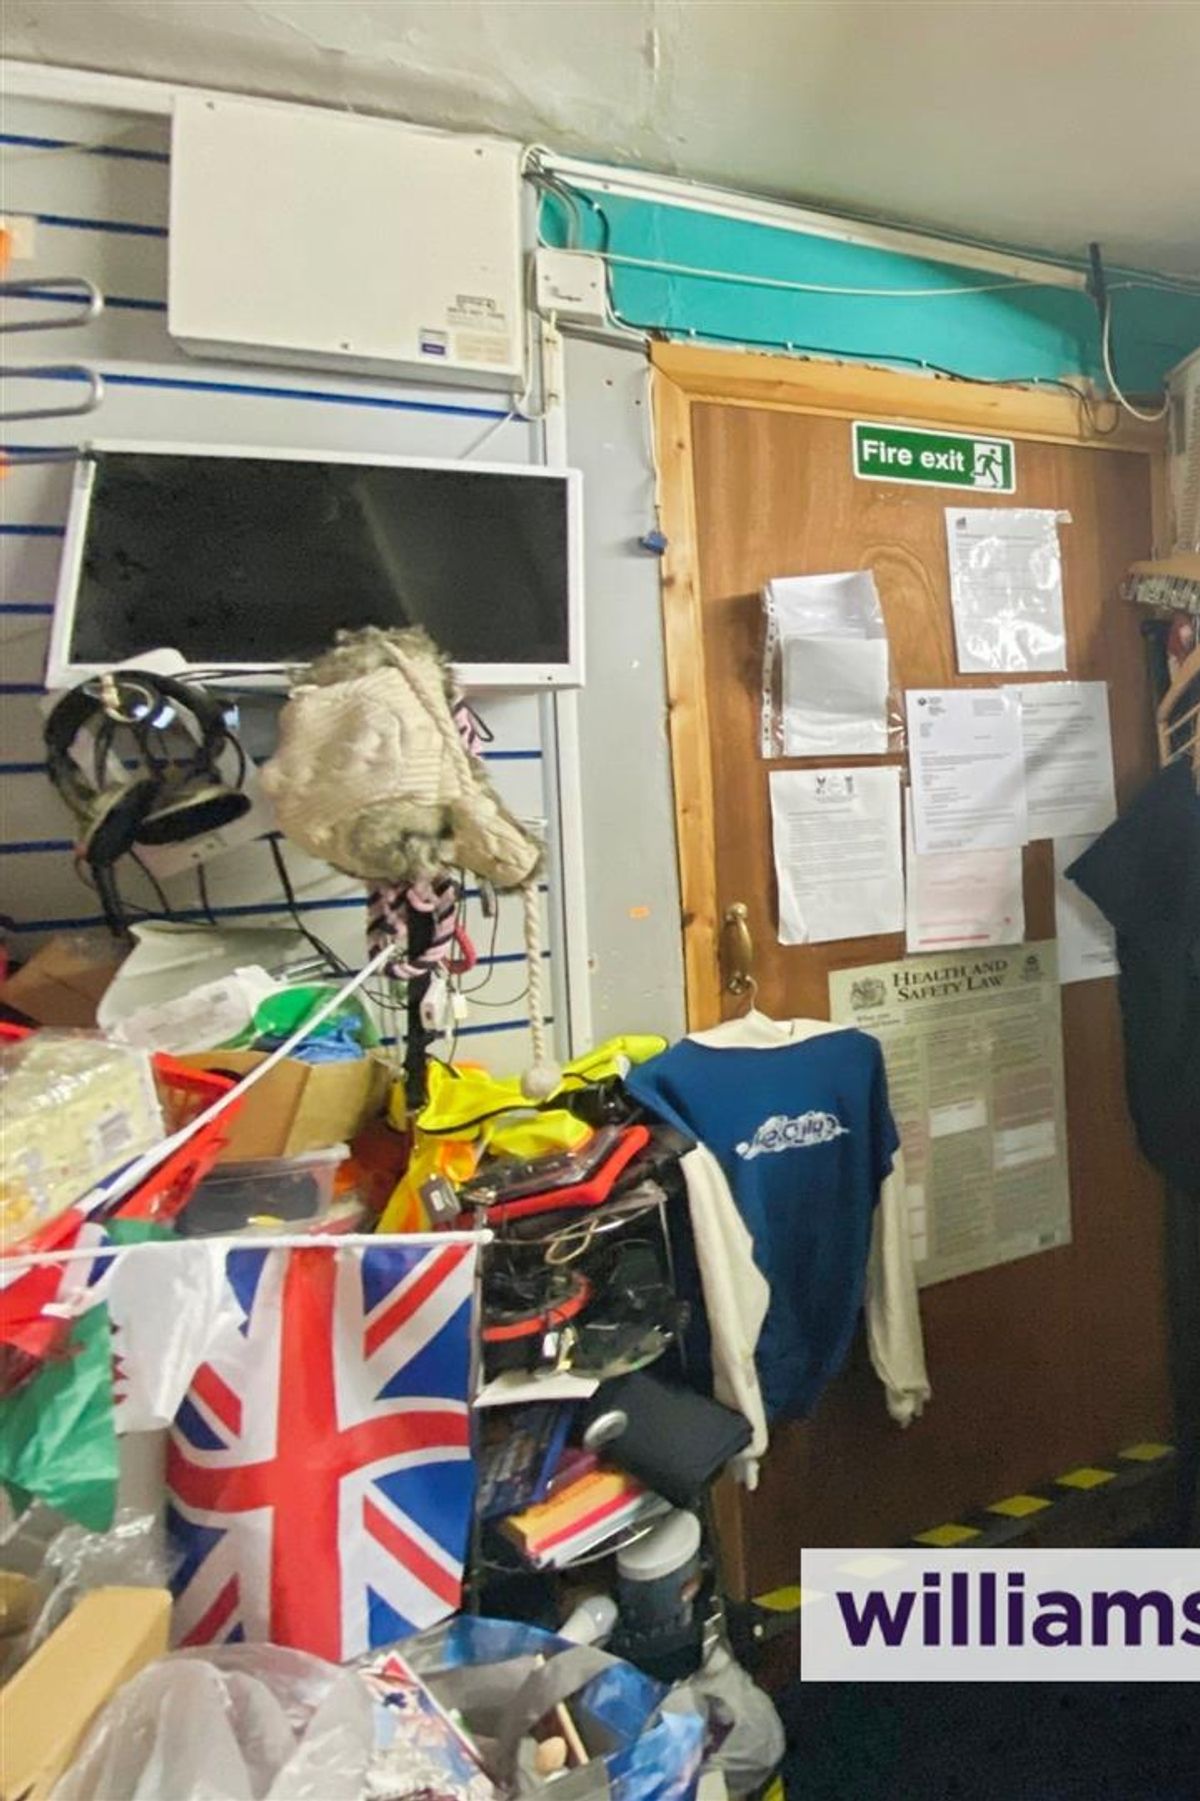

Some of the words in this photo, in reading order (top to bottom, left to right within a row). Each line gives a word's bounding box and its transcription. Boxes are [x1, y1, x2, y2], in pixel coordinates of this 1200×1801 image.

[862, 439, 913, 466] Fire
[920, 448, 965, 472] exit
[893, 966, 966, 987] HEALTH
[972, 960, 1008, 975] AND
[898, 982, 961, 1001] SAFETY
[967, 975, 1003, 990] LAW
